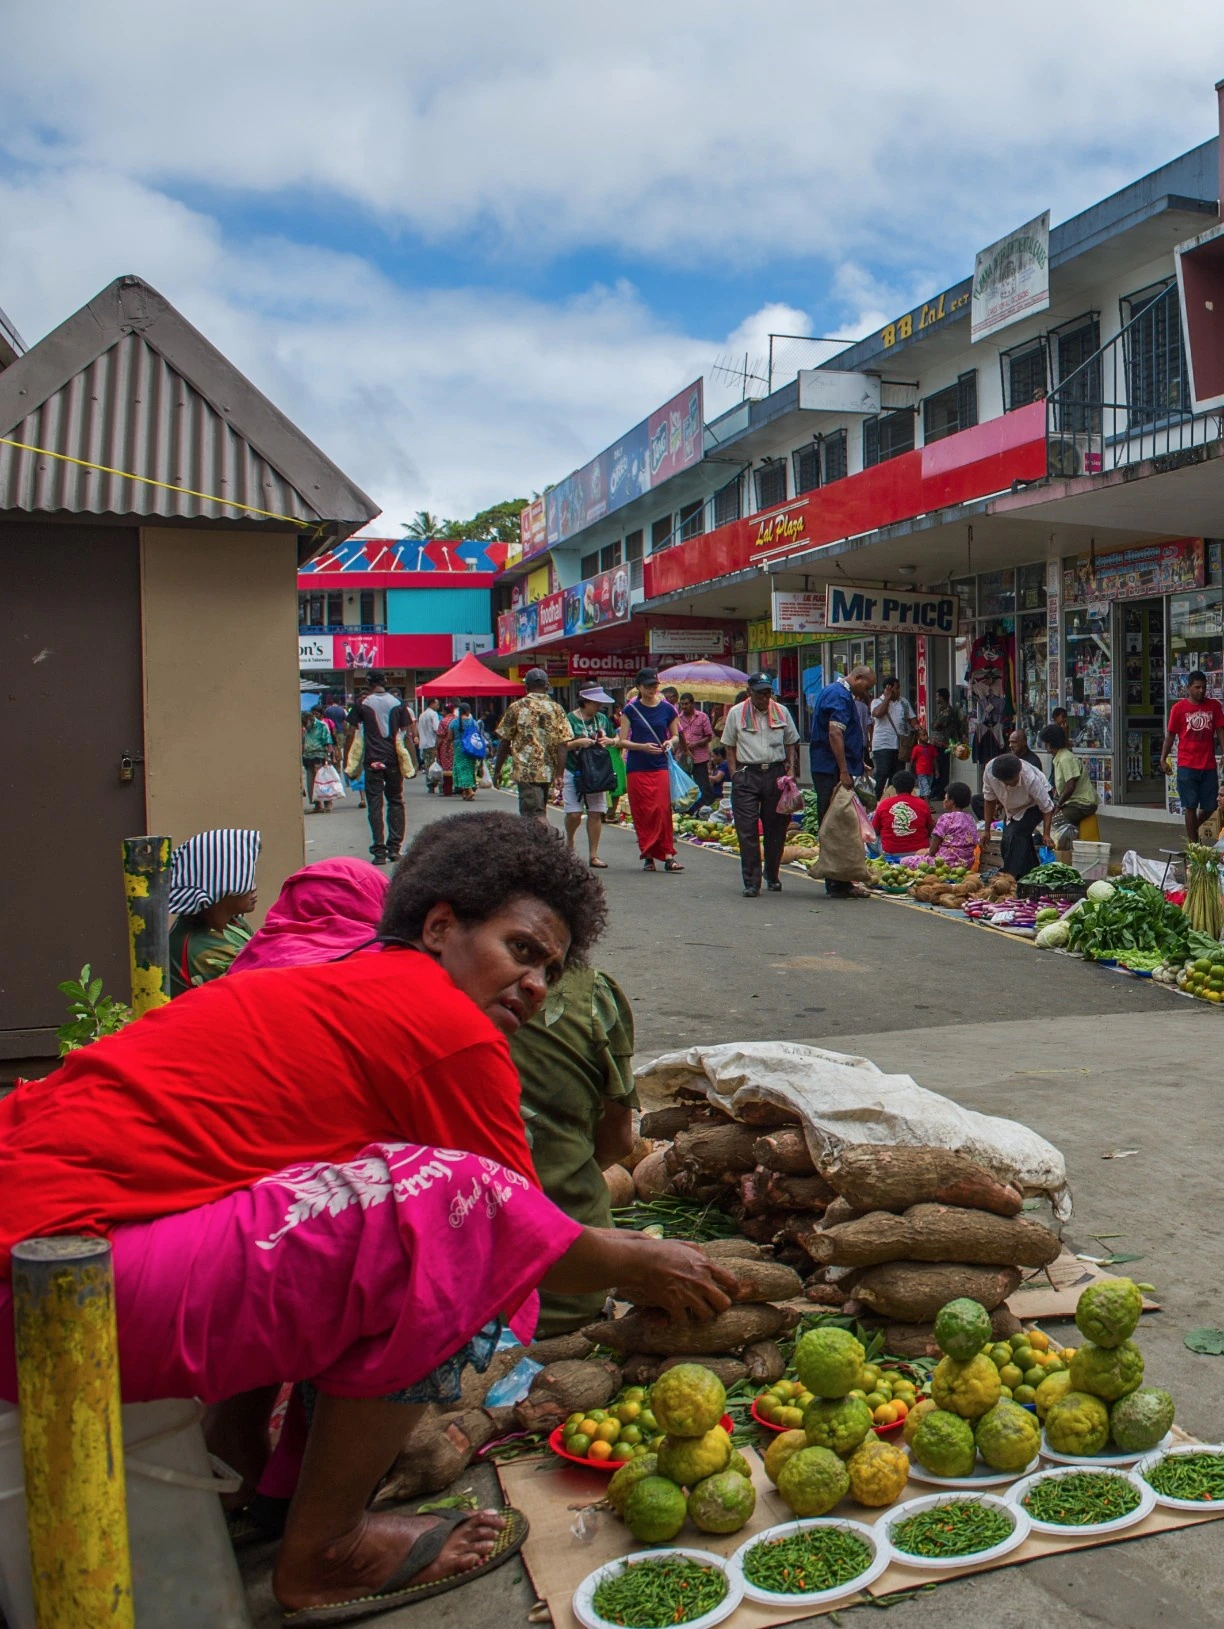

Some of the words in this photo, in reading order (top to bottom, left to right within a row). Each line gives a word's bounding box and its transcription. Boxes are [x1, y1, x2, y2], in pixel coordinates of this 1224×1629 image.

[610, 455, 628, 494] OREO
[775, 513, 805, 543] Plaza
[541, 595, 563, 626] foodhall
[832, 588, 878, 624] Mr
[882, 598, 955, 632] Price
[572, 653, 646, 670] foodhall
